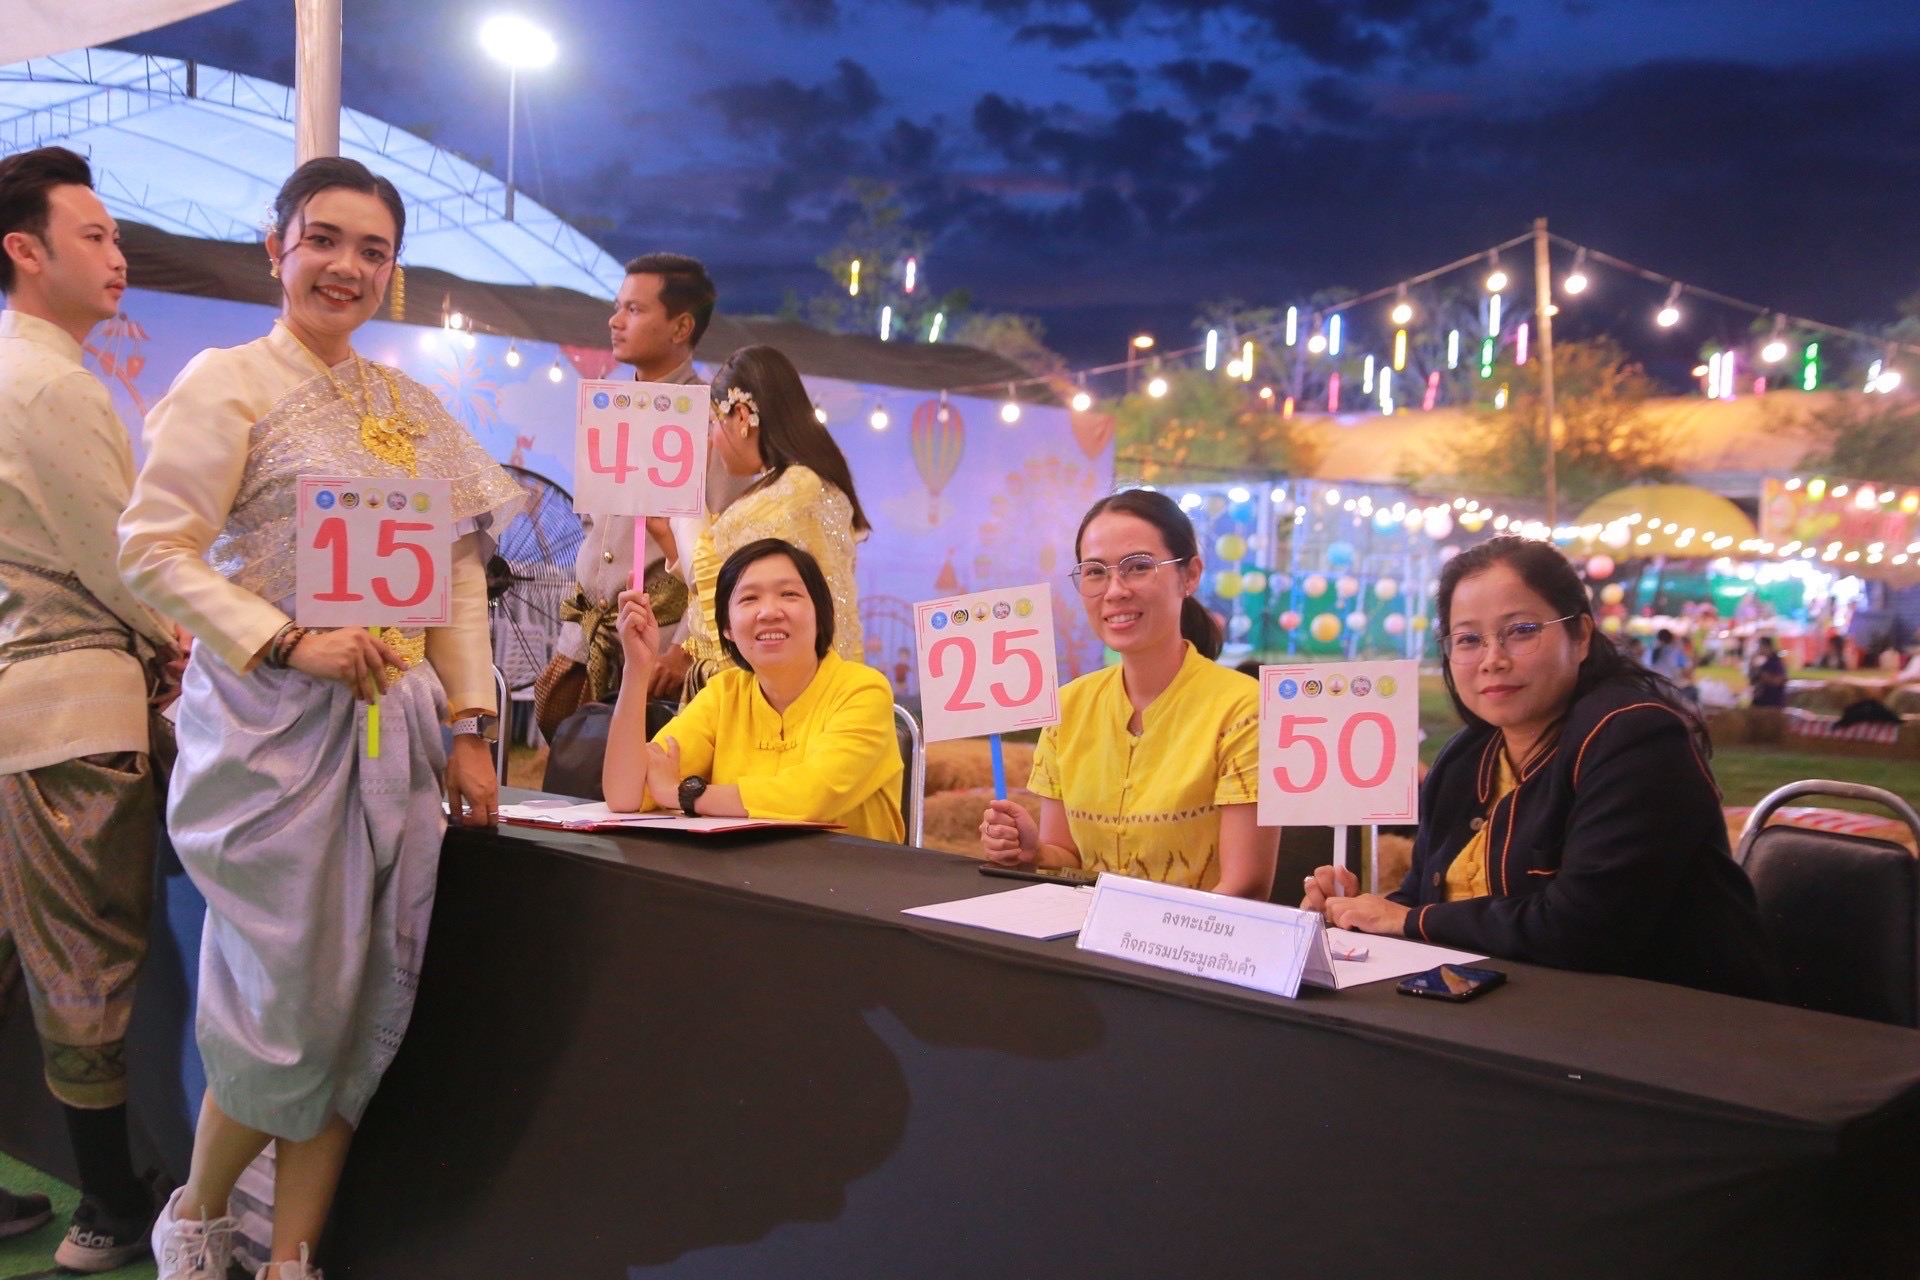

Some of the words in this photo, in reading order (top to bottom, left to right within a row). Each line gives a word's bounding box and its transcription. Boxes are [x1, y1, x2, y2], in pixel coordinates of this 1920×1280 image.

[586, 421, 695, 489] 49
[312, 516, 436, 608] 15
[927, 627, 1044, 713] 25
[1272, 710, 1398, 794] 50
[1120, 932, 1256, 977] กิจกรรมประมูลสินค้า
[1161, 911, 1235, 937] ลงทะเบียน
[68, 1225, 114, 1248] didas
